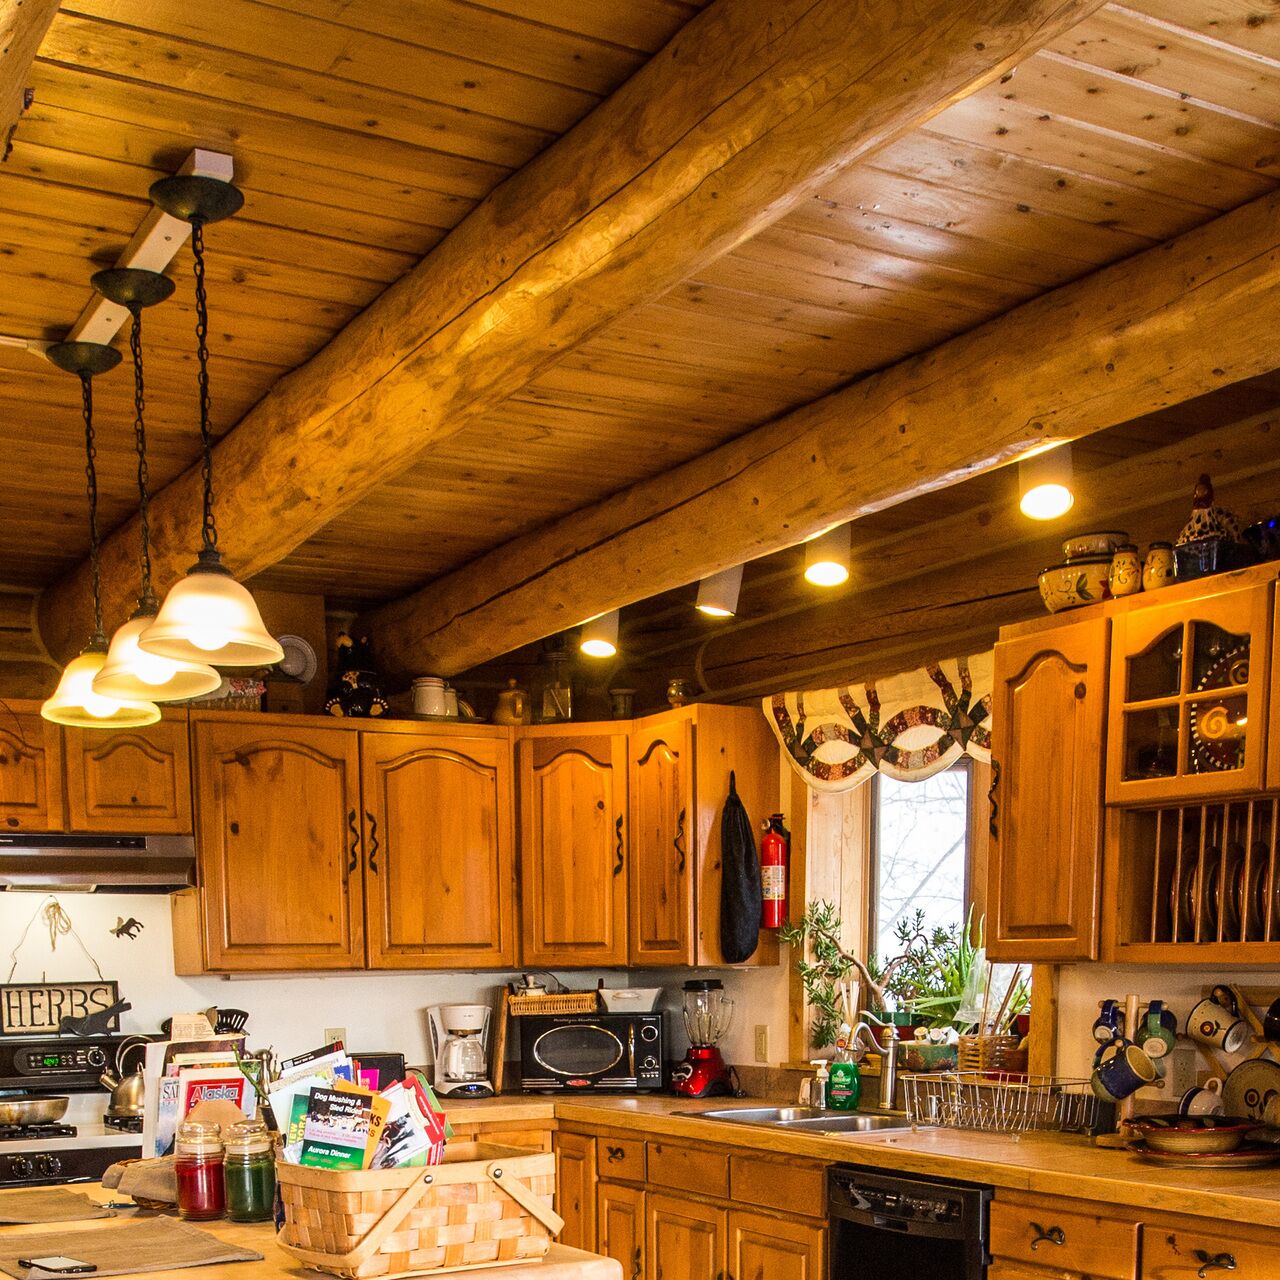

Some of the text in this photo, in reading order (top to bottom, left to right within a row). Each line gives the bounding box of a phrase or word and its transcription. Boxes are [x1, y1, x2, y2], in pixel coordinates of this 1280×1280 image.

[5, 987, 109, 1027] HERBS
[190, 1085, 239, 1102] Alaska
[314, 1092, 328, 1102] Dog
[328, 1095, 356, 1106] Mushing
[329, 1103, 344, 1112] Sled
[308, 1145, 352, 1159] Aurora Dinner
